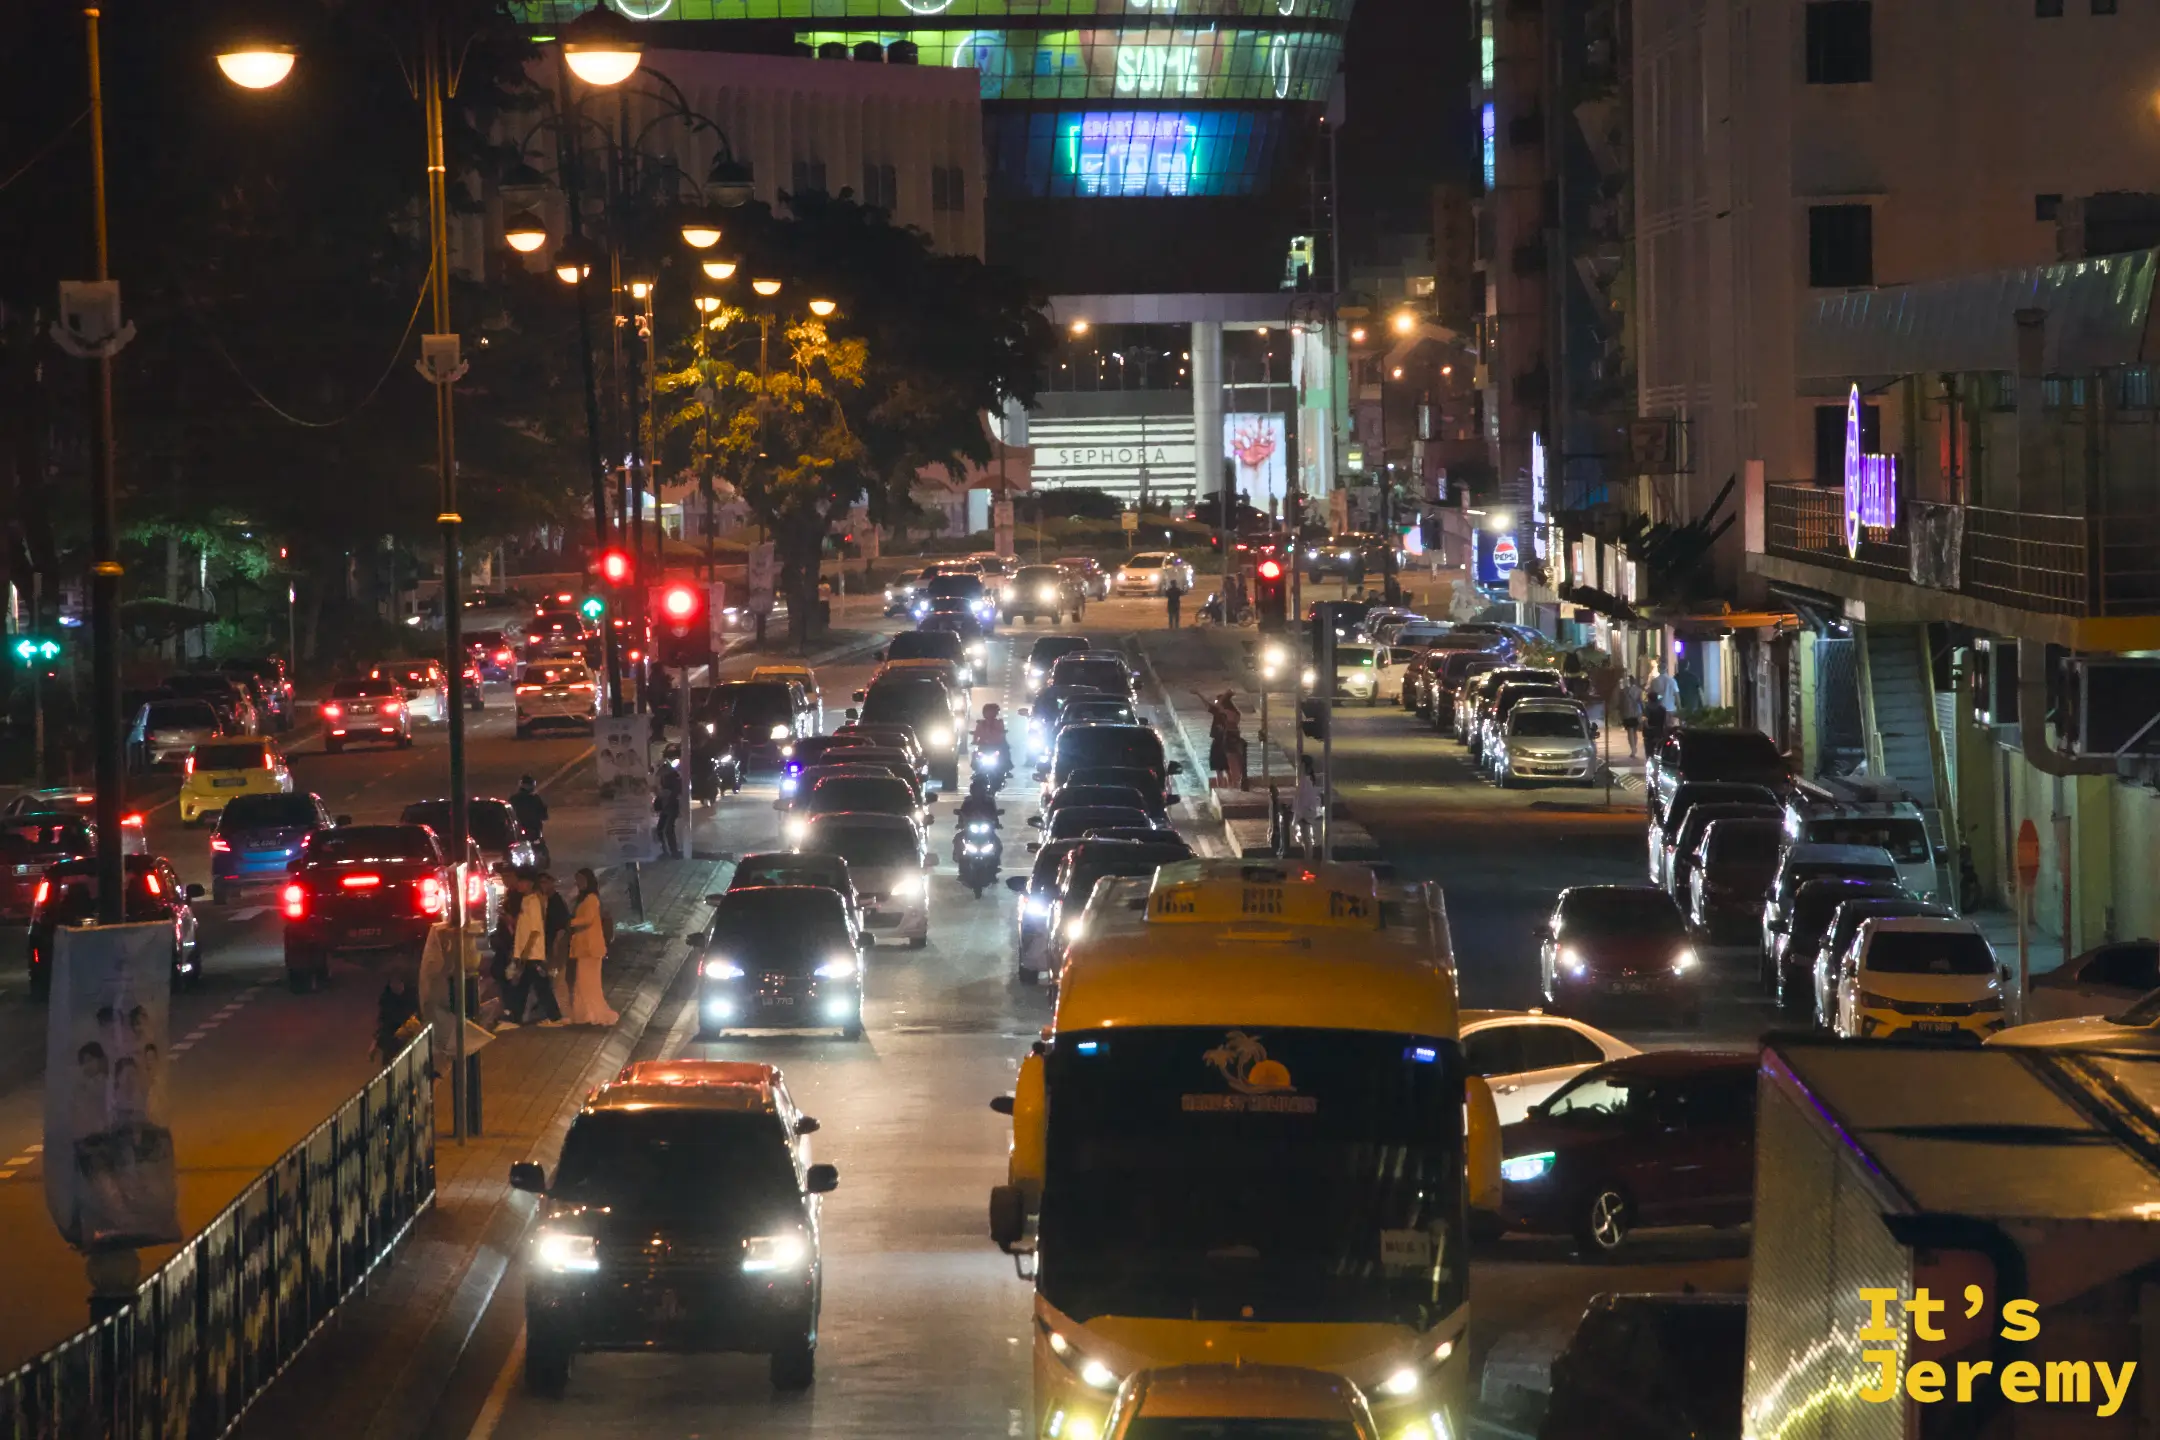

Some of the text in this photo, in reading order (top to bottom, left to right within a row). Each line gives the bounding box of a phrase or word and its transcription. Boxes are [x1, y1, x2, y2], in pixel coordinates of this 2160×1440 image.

[1117, 46, 1198, 92] SOME
[1059, 447, 1166, 464] SEPHORA
[1494, 552, 1517, 561] PEPSI
